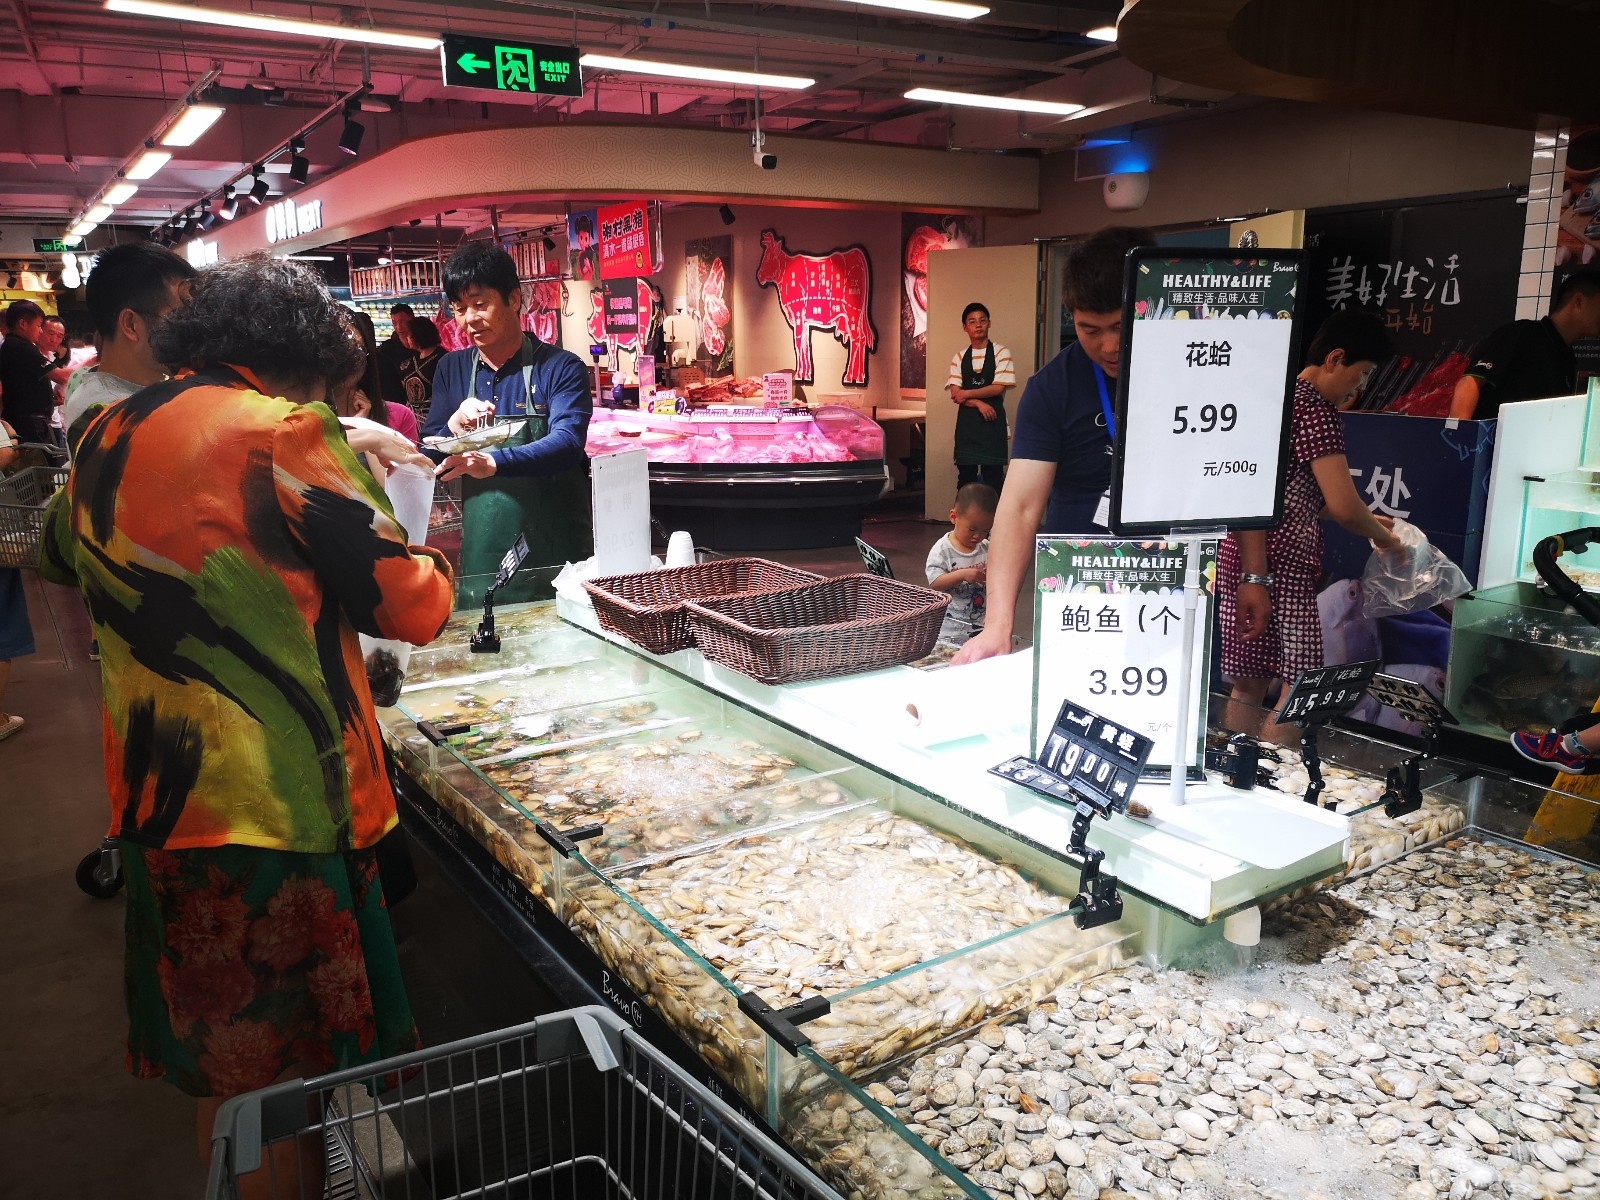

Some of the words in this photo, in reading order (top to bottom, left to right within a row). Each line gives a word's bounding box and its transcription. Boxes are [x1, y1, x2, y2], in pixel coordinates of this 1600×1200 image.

[540, 60, 570, 75] 安全出口
[544, 73, 567, 83] EXIT
[1272, 262, 1294, 273] Bravo
[1162, 274, 1272, 289] HEALTHY&LIFE
[1326, 254, 1461, 311] 美好生活
[1172, 292, 1259, 305] 精致生活·品味人生
[1185, 340, 1233, 368] 花蛤
[1173, 403, 1238, 435] 5.99
[1203, 460, 1258, 477] 元/500g
[1349, 465, 1412, 519] 处
[1071, 556, 1183, 569] HEALTHY&LIFE
[1081, 571, 1171, 583] 精致生活·品味人生
[1088, 666, 1168, 697] 3.99
[1146, 722, 1172, 733] 元/个
[1047, 735, 1110, 784] 19.00
[602, 970, 630, 1016] Bravo
